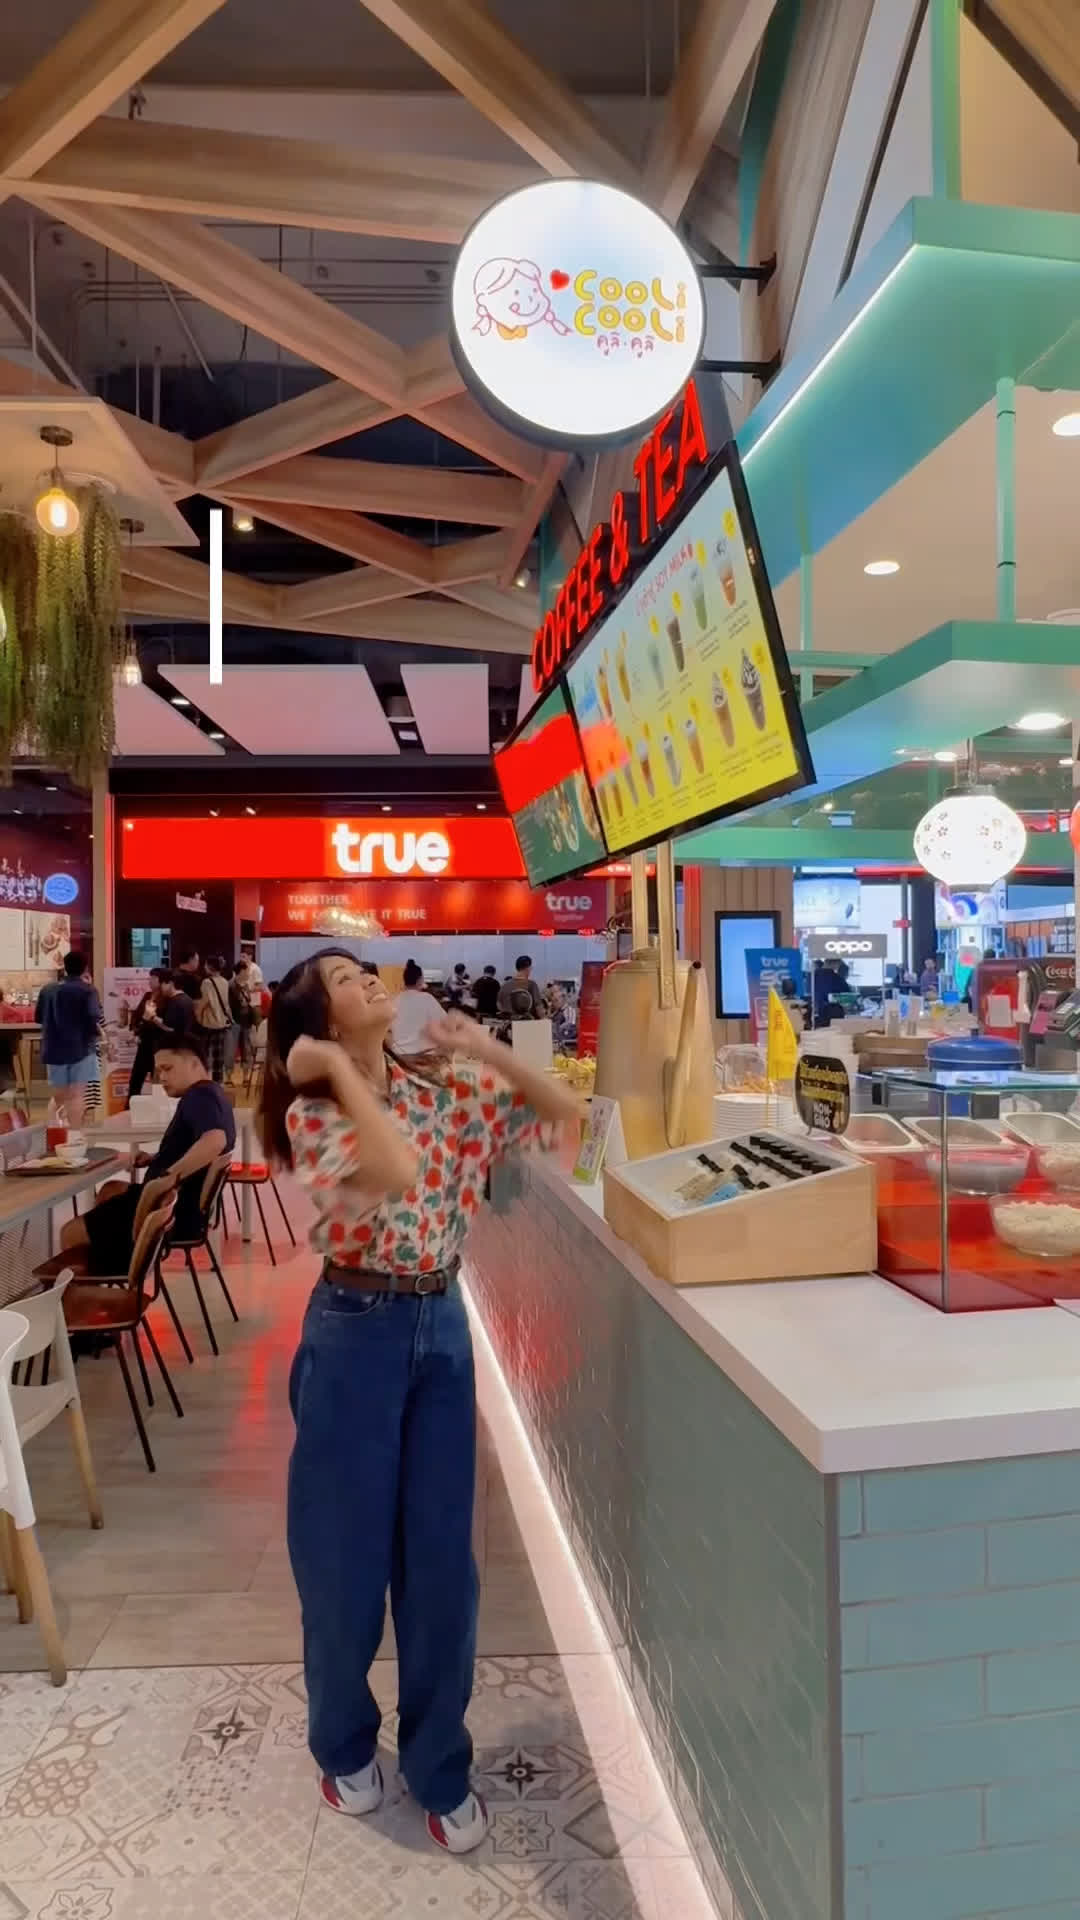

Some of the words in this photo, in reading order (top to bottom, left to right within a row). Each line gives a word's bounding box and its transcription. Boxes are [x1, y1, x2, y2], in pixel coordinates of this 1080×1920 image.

[531, 522, 605, 694] COFFEE
[609, 490, 629, 585] &
[633, 376, 708, 544] TEA
[331, 823, 451, 874] true
[545, 892, 592, 911] true
[288, 911, 305, 921] WE
[382, 909, 392, 920] IT
[397, 908, 427, 920] TRUE
[760, 956, 789, 967] true
